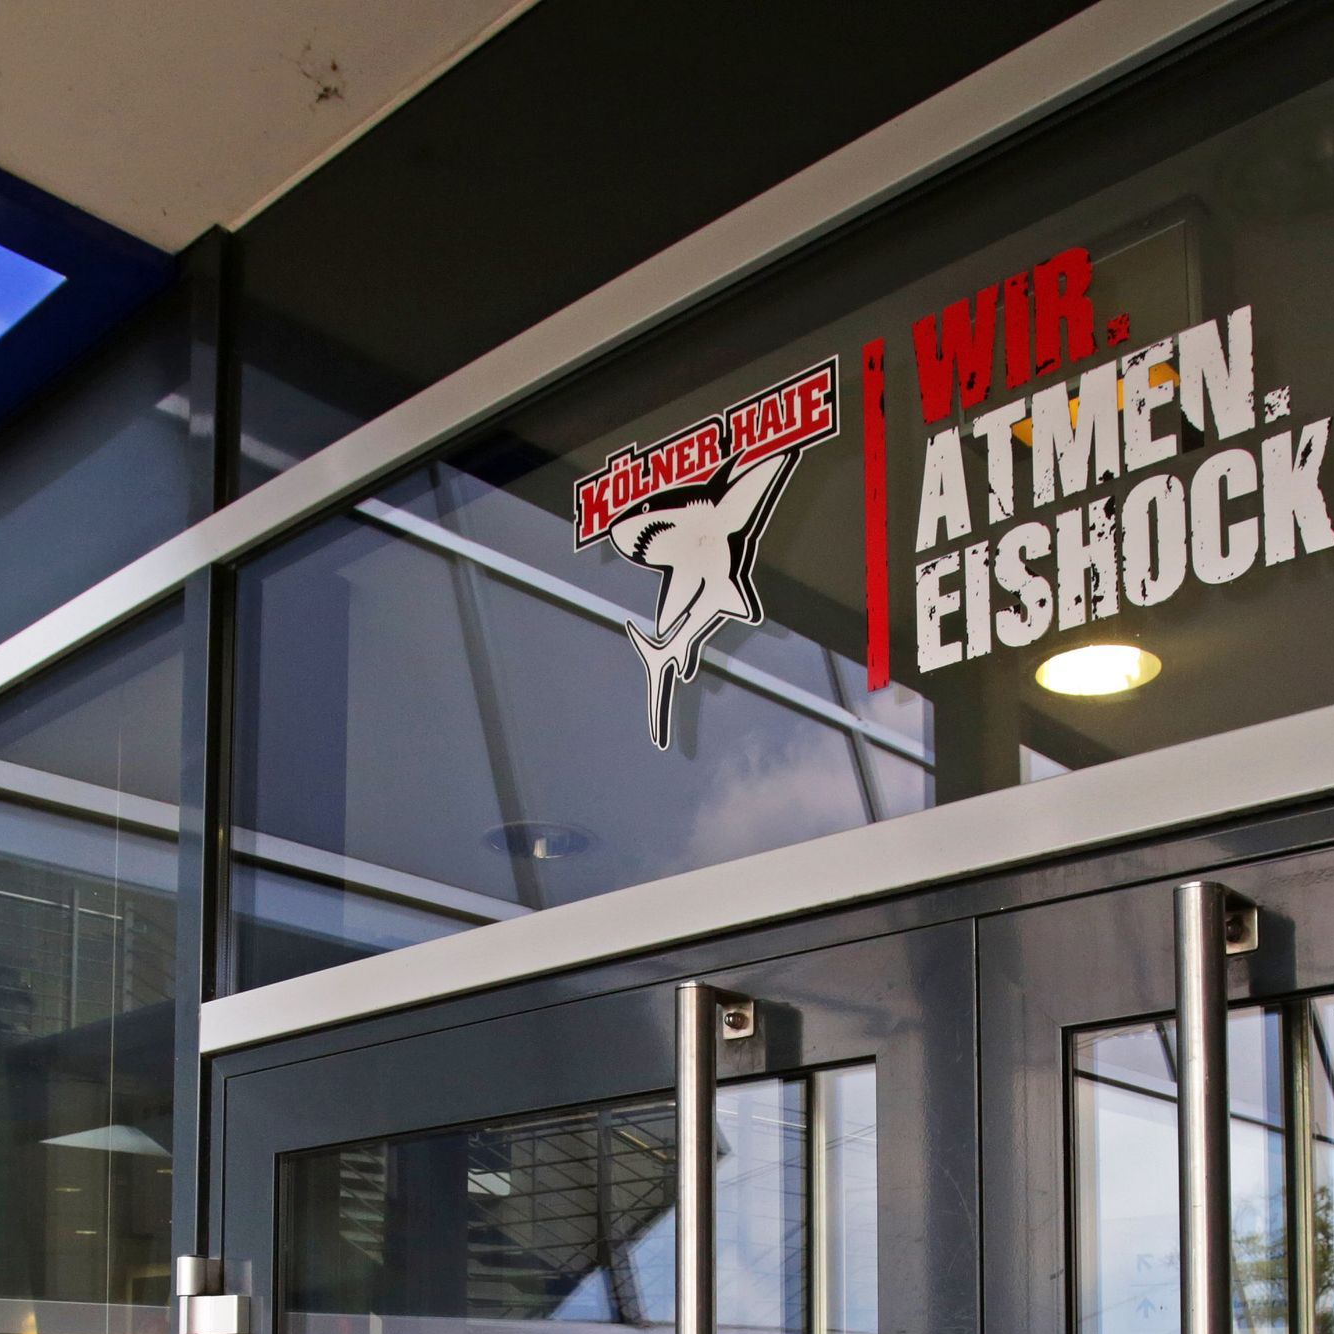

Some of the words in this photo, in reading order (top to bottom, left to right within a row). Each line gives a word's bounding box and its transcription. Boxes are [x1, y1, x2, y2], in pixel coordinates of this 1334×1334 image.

[913, 246, 1131, 424] WIR.
[577, 425, 723, 539] KÖLNER
[727, 367, 835, 454] HAIE
[915, 304, 1292, 552] ATMEN.
